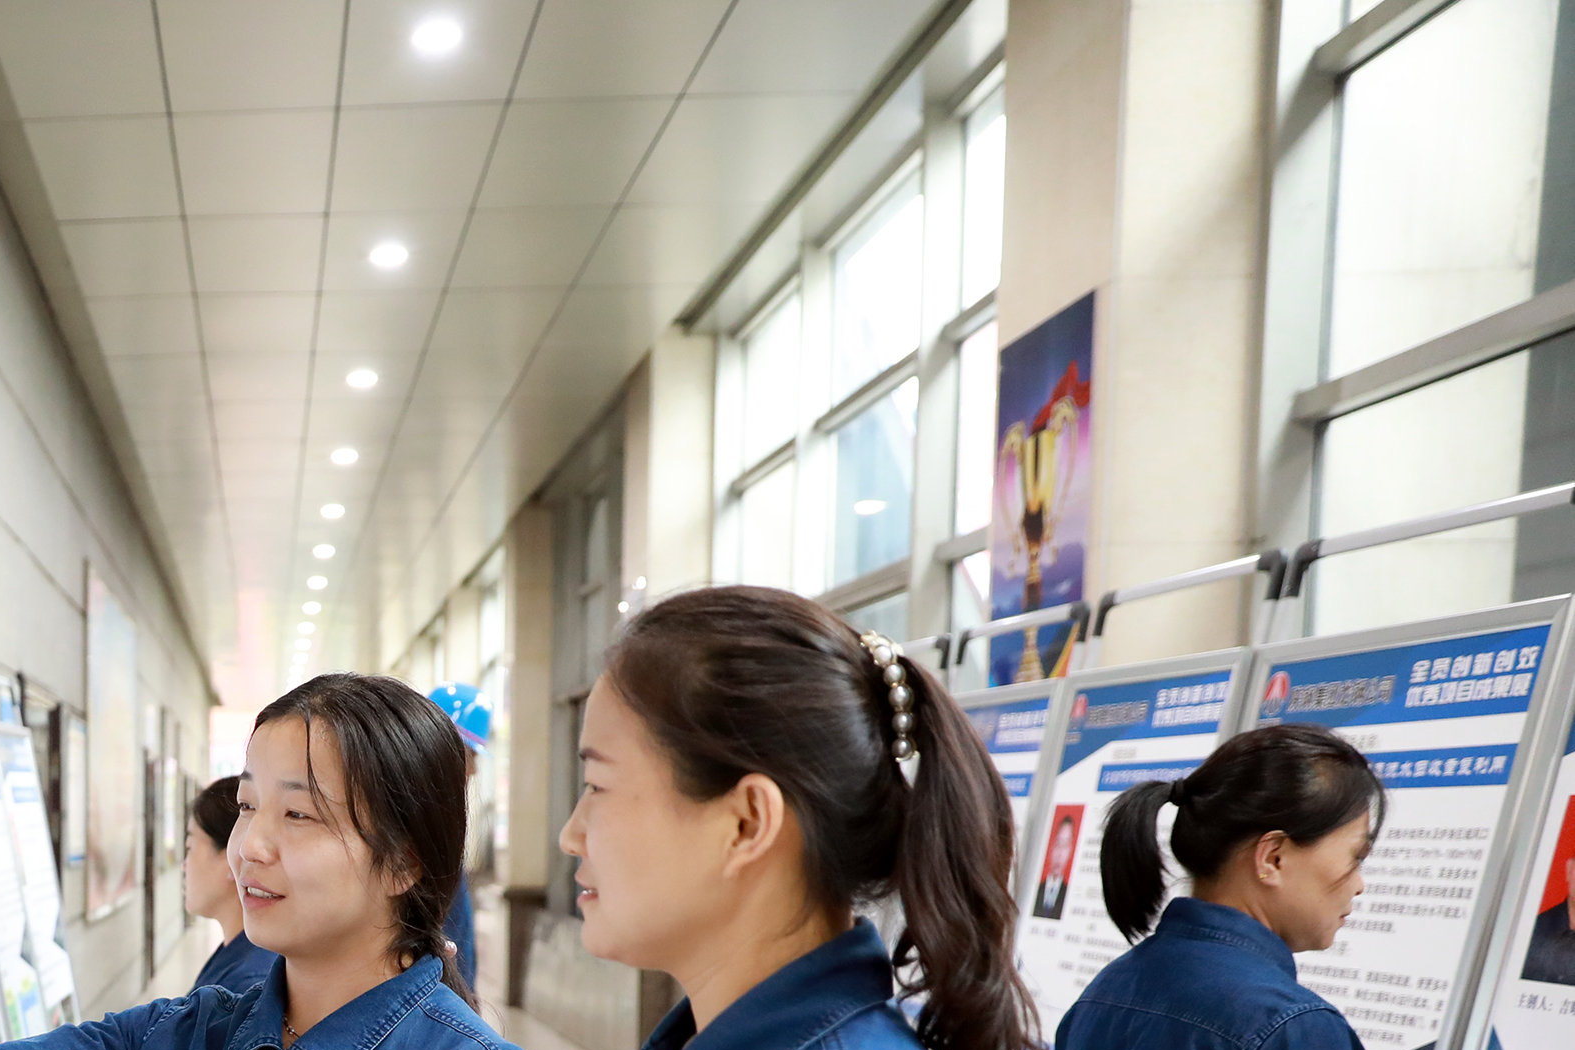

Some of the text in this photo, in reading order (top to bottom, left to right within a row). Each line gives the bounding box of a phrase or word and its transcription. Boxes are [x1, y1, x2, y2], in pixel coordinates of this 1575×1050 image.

[1408, 645, 1541, 684] 全员创新创效
[1405, 672, 1534, 708] 优秀项目成果展
